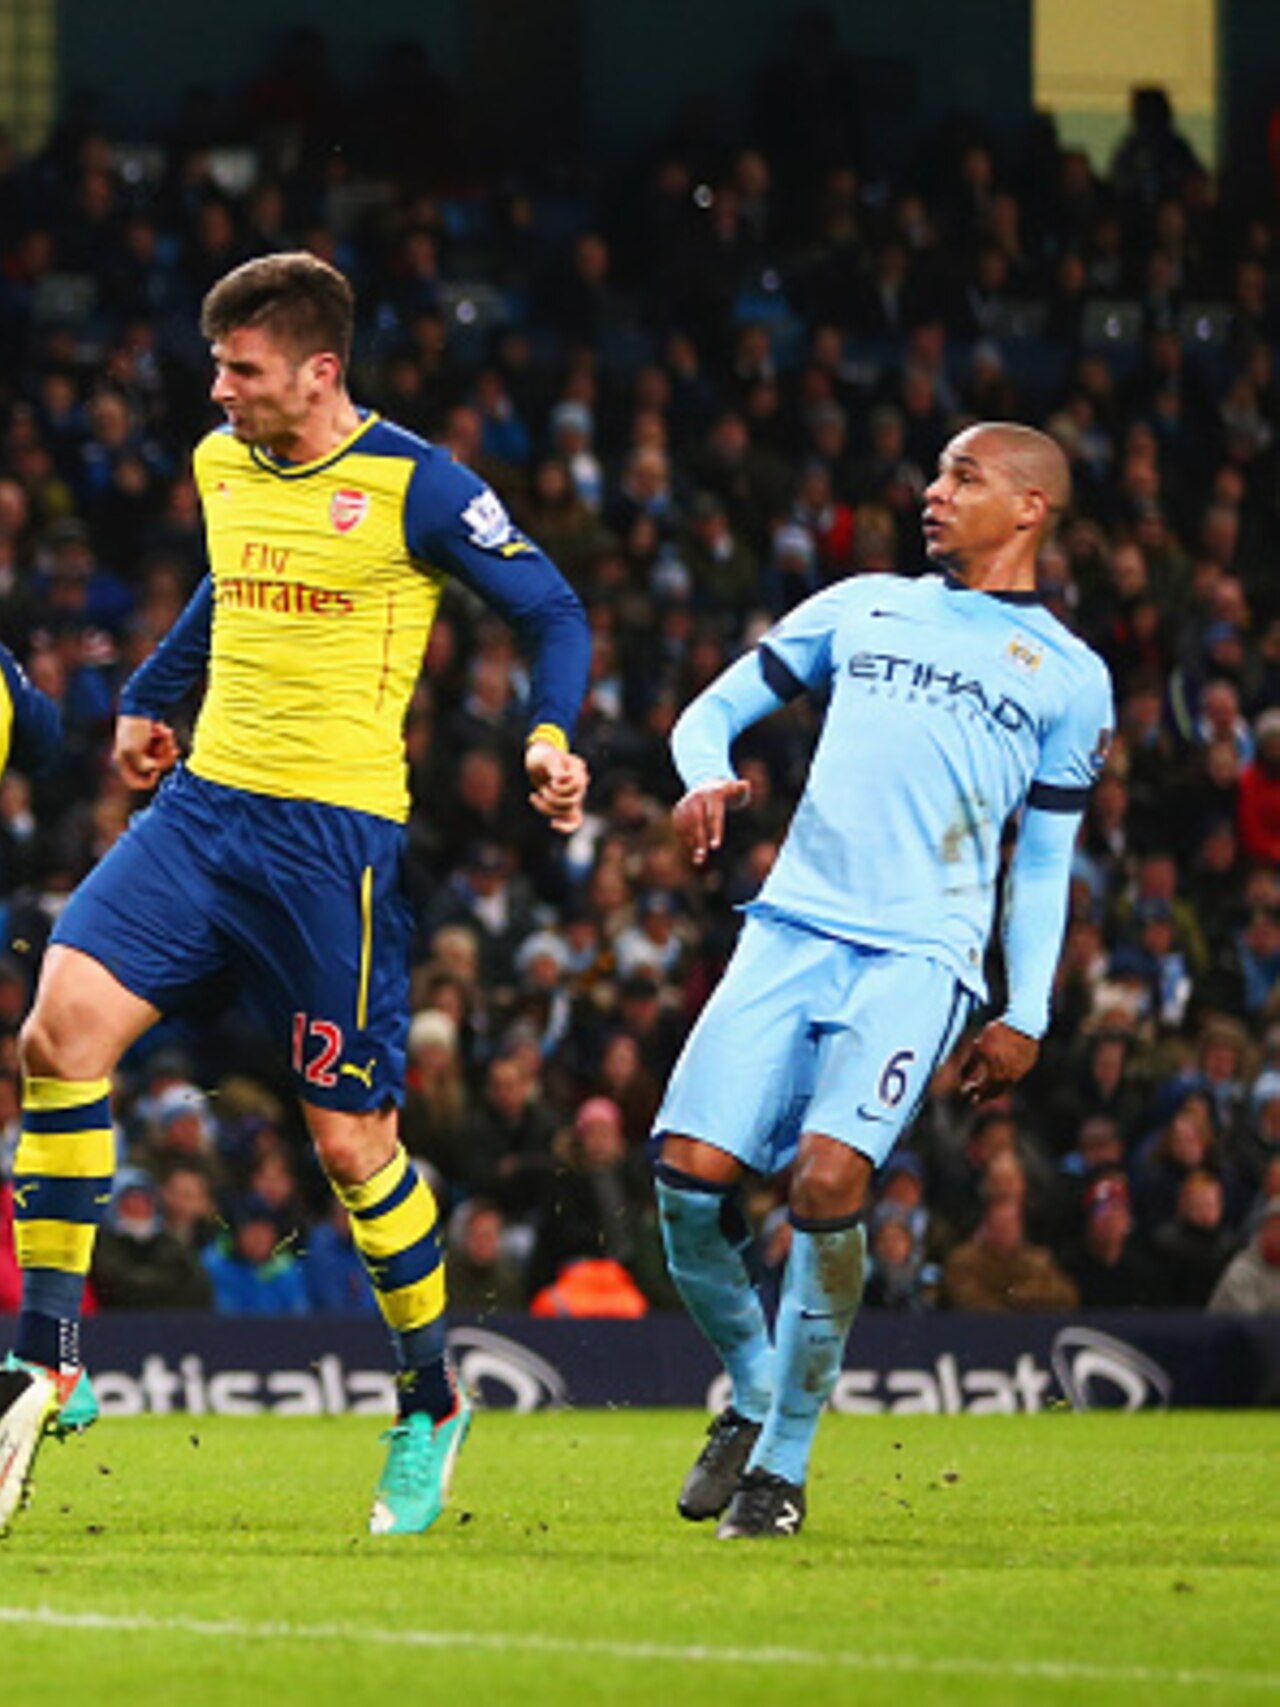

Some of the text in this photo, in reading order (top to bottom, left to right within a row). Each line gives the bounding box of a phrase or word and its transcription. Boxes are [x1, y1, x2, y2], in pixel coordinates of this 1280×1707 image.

[241, 543, 289, 574] Fly
[218, 577, 355, 617] mirates
[849, 653, 1036, 733] ETIHAD
[291, 1012, 343, 1088] 12
[879, 1050, 915, 1107] 6
